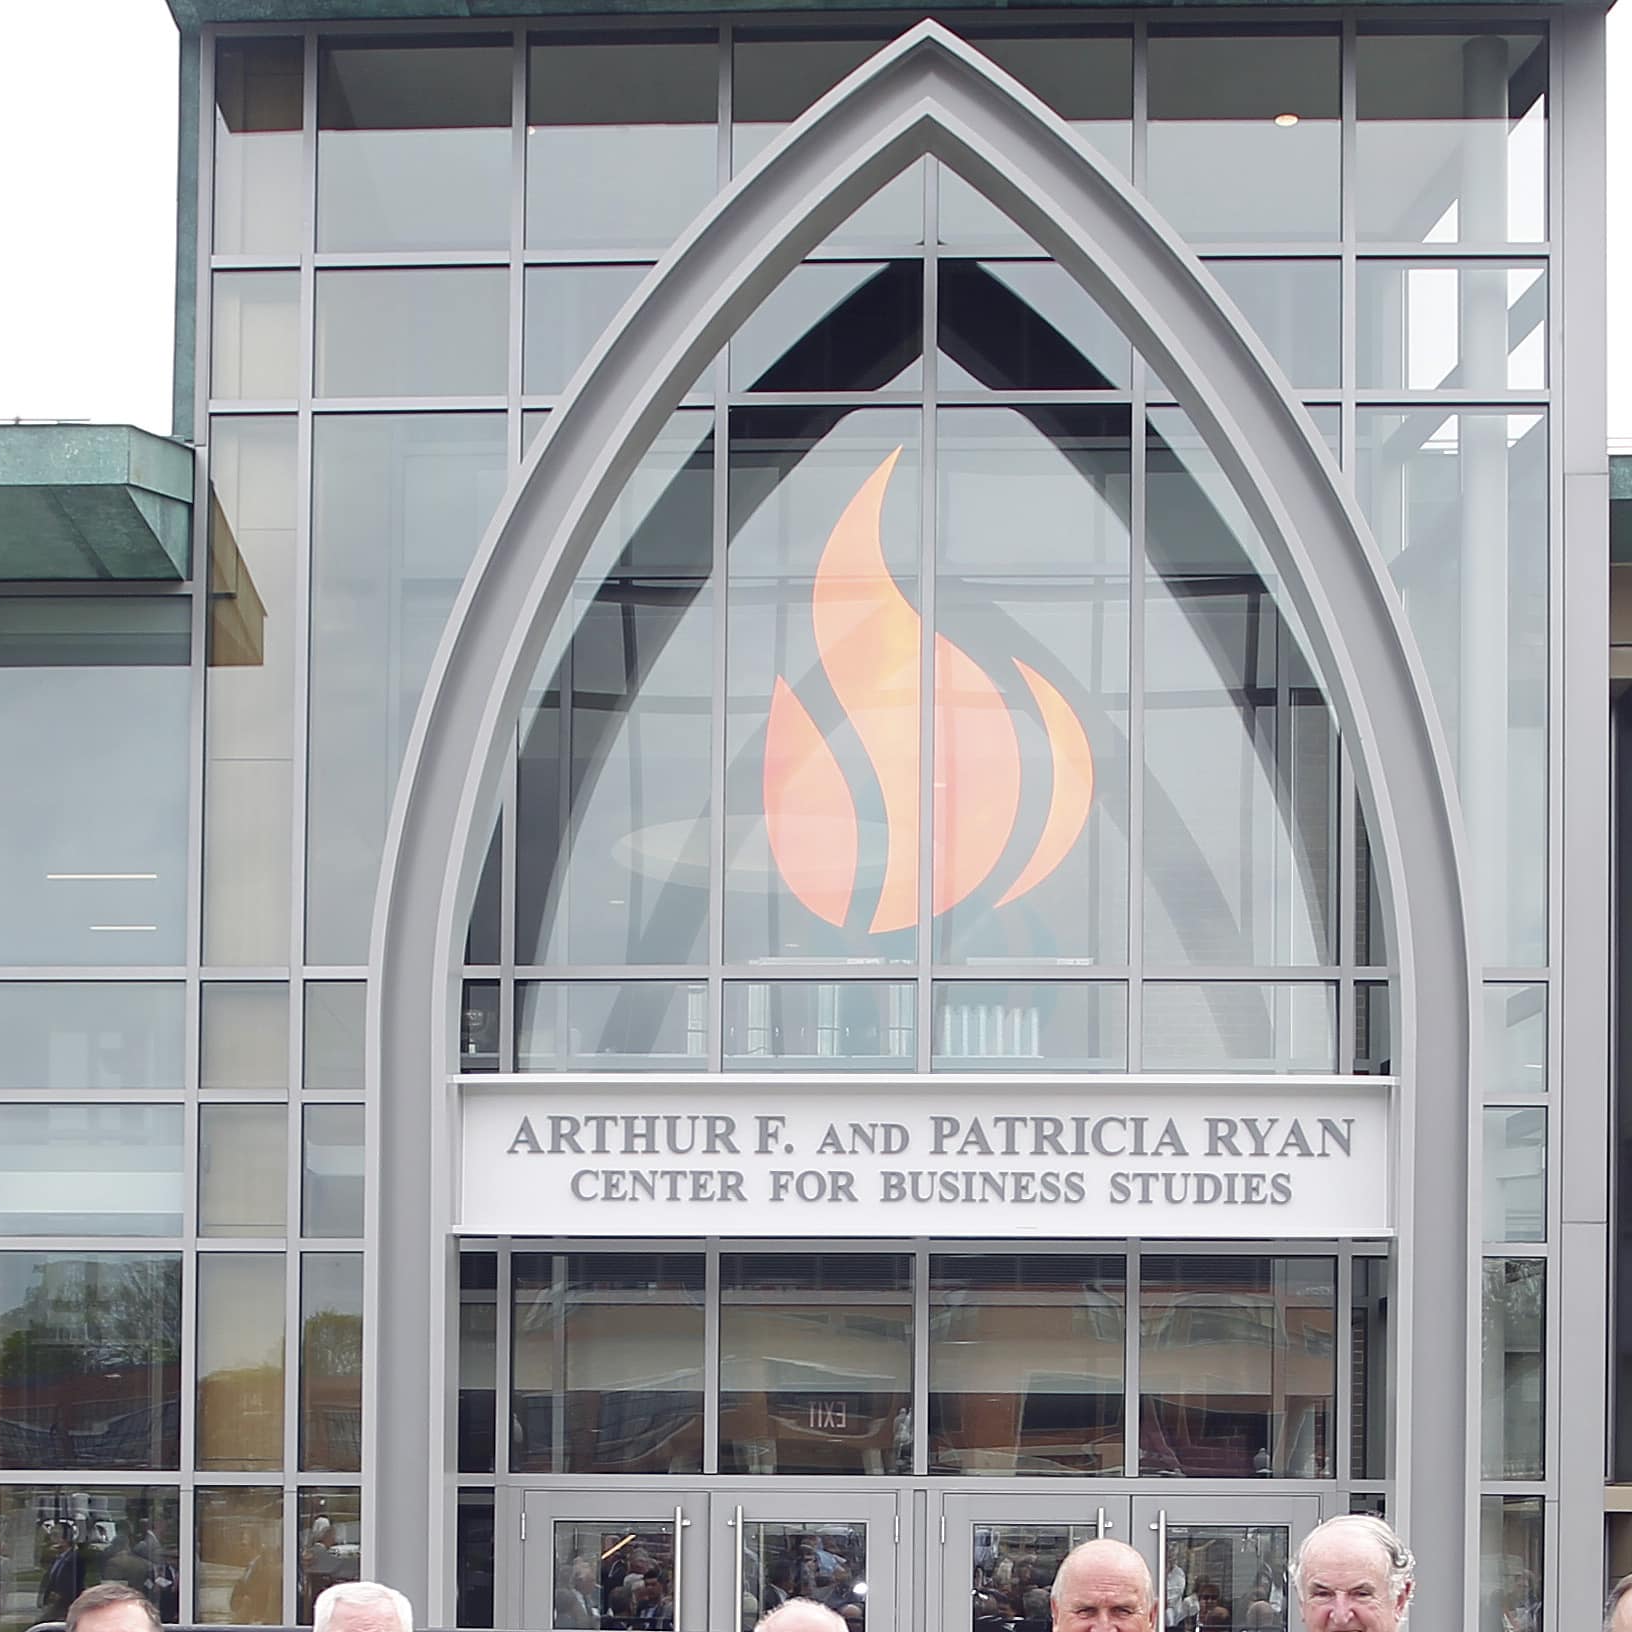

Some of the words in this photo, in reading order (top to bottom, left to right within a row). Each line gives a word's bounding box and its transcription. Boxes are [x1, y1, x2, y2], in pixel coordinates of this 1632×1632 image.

[506, 1115, 741, 1154] ARTHUR
[753, 1115, 794, 1154] F.
[816, 1123, 910, 1154] AND
[928, 1115, 1189, 1157] PATRICIA
[1203, 1117, 1355, 1157] RYAN
[570, 1169, 747, 1202] CENTER
[769, 1170, 858, 1202] FOR
[879, 1170, 1086, 1204] BUSINESS
[1109, 1171, 1292, 1205] STUDIES
